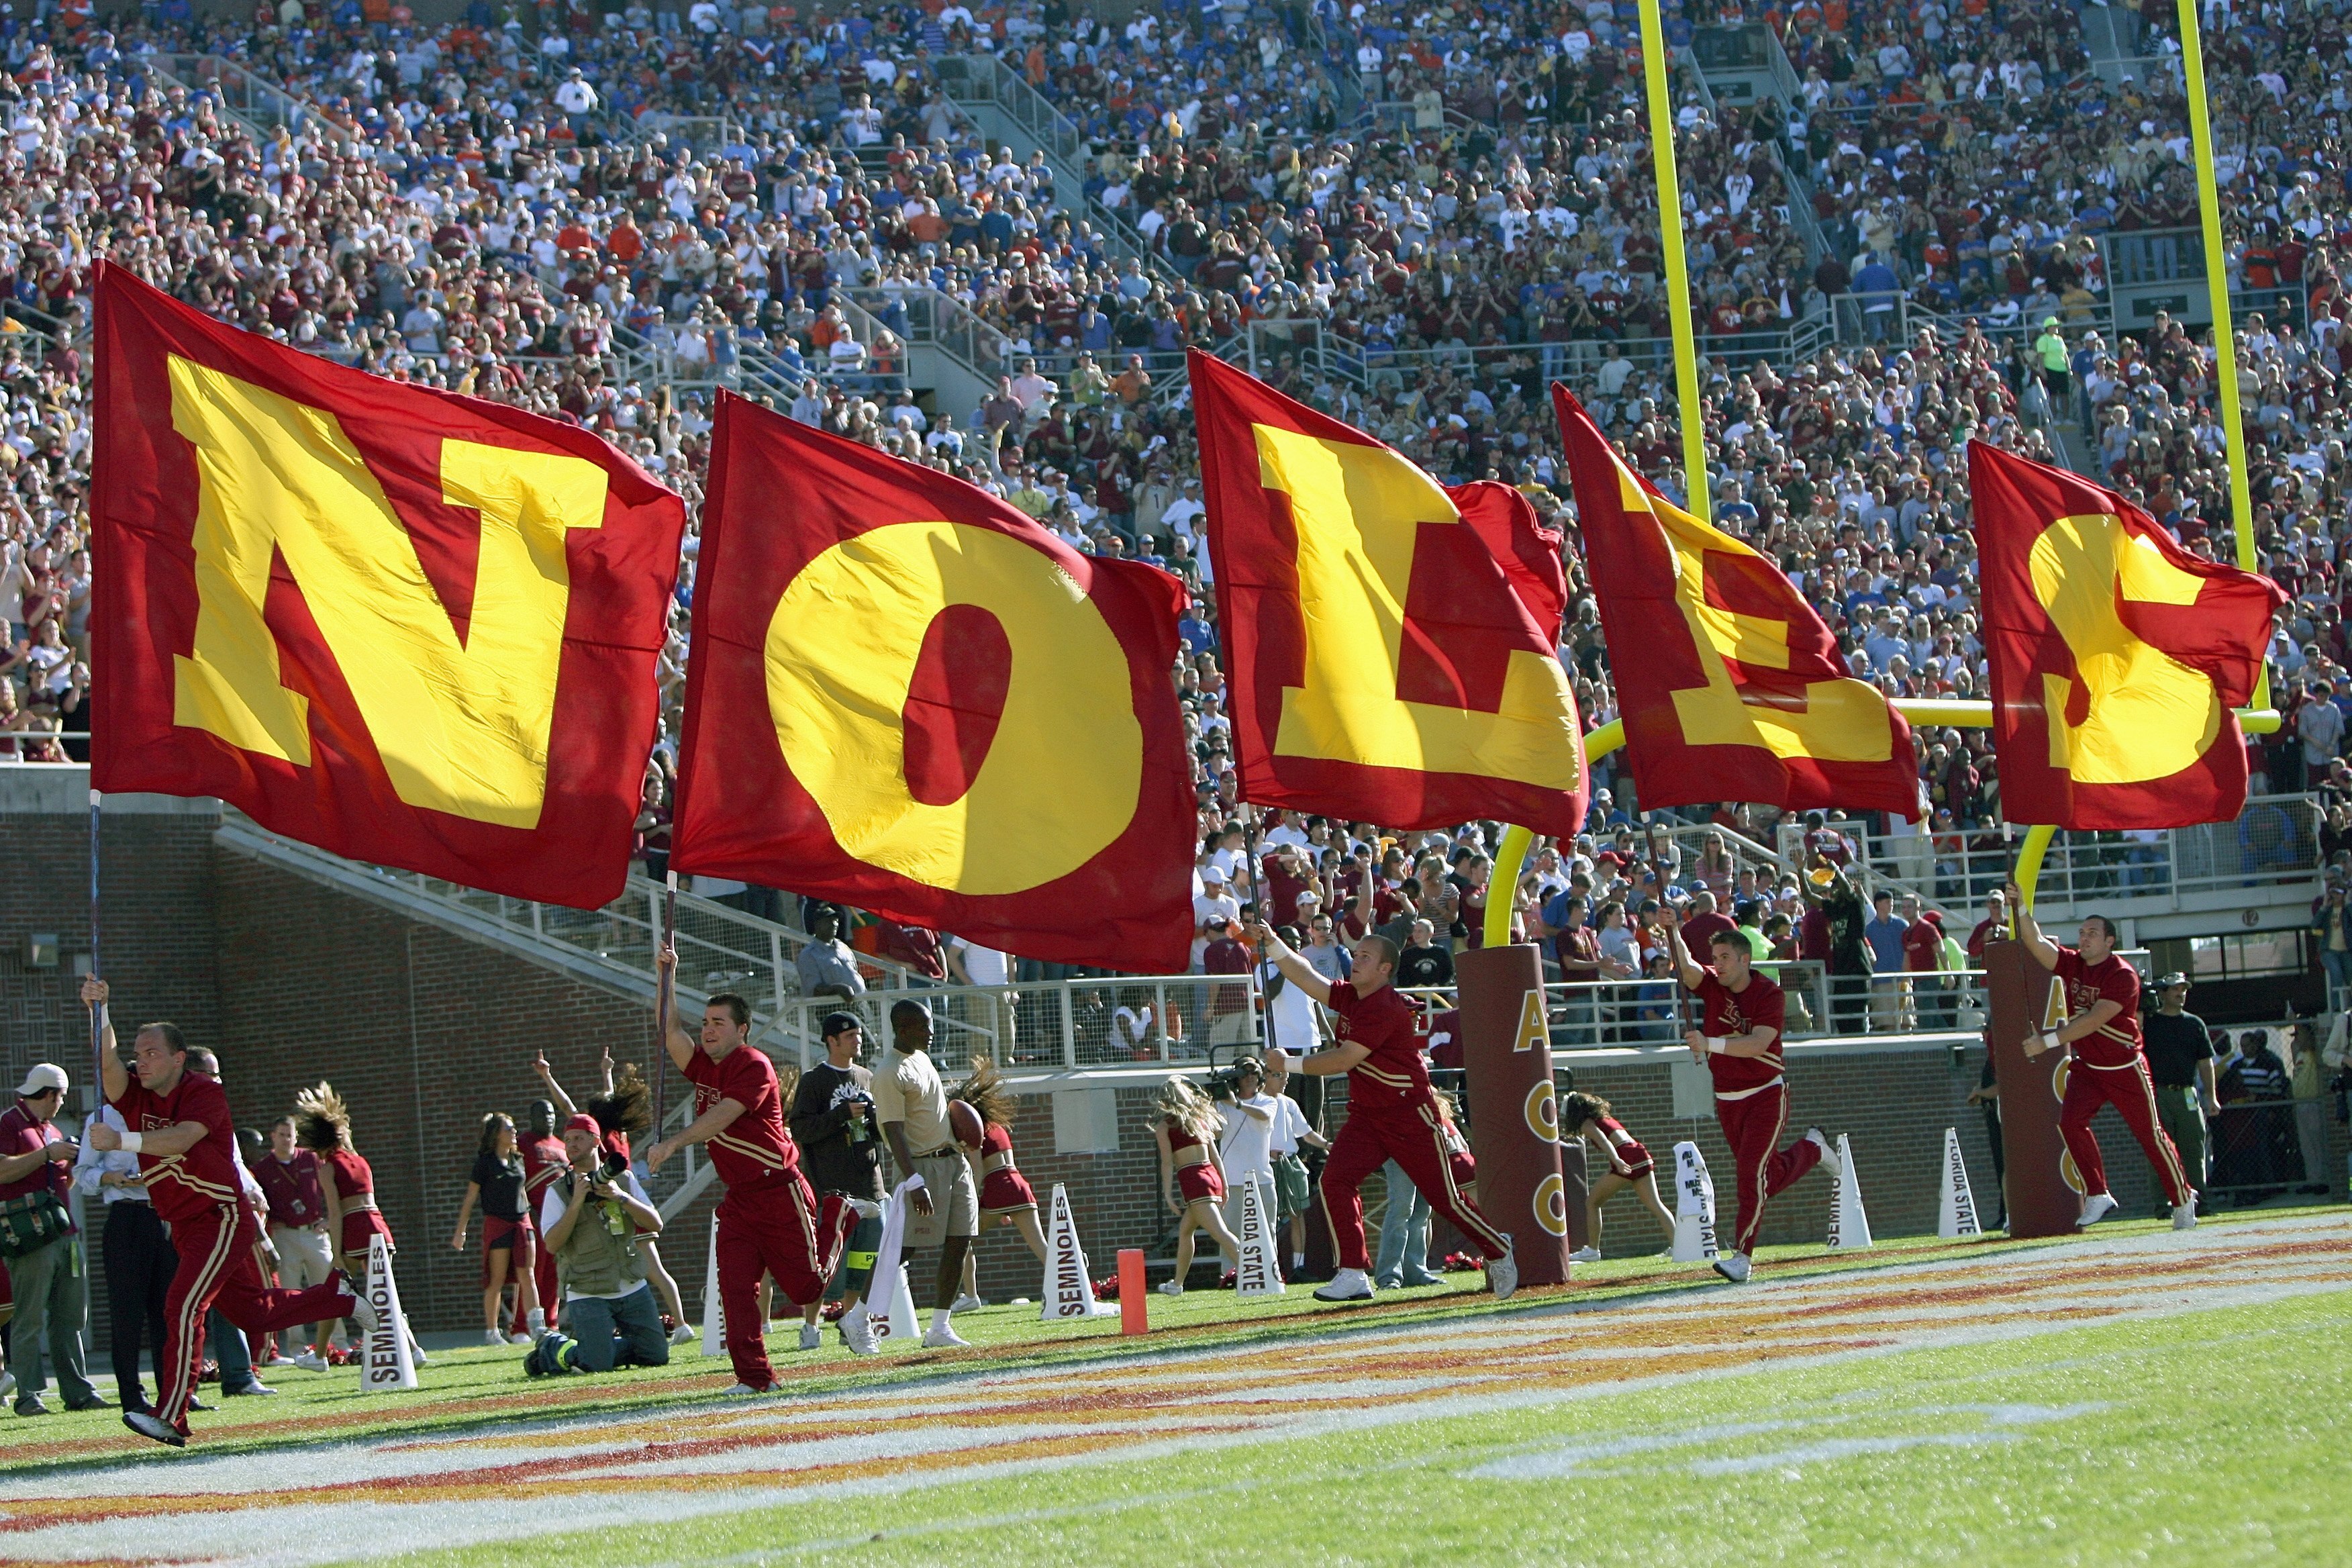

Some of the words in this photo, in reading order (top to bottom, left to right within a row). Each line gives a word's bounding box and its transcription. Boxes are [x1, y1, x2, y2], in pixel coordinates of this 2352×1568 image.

[2009, 71, 2016, 84] 7
[1154, 493, 1160, 509] 1
[166, 352, 608, 829] N
[1252, 423, 1579, 792] L
[1610, 449, 1893, 762] E
[2029, 514, 2220, 784] S
[764, 522, 1144, 895] O
[1243, 1180, 1260, 1242] FLORIDA
[1950, 1138, 1967, 1192] FLORIDA
[1955, 1195, 1976, 1234] STATE
[371, 1246, 402, 1383] SEMINOLES
[1056, 1195, 1086, 1316] SEMINOLES
[1242, 1246, 1266, 1291] STATE
